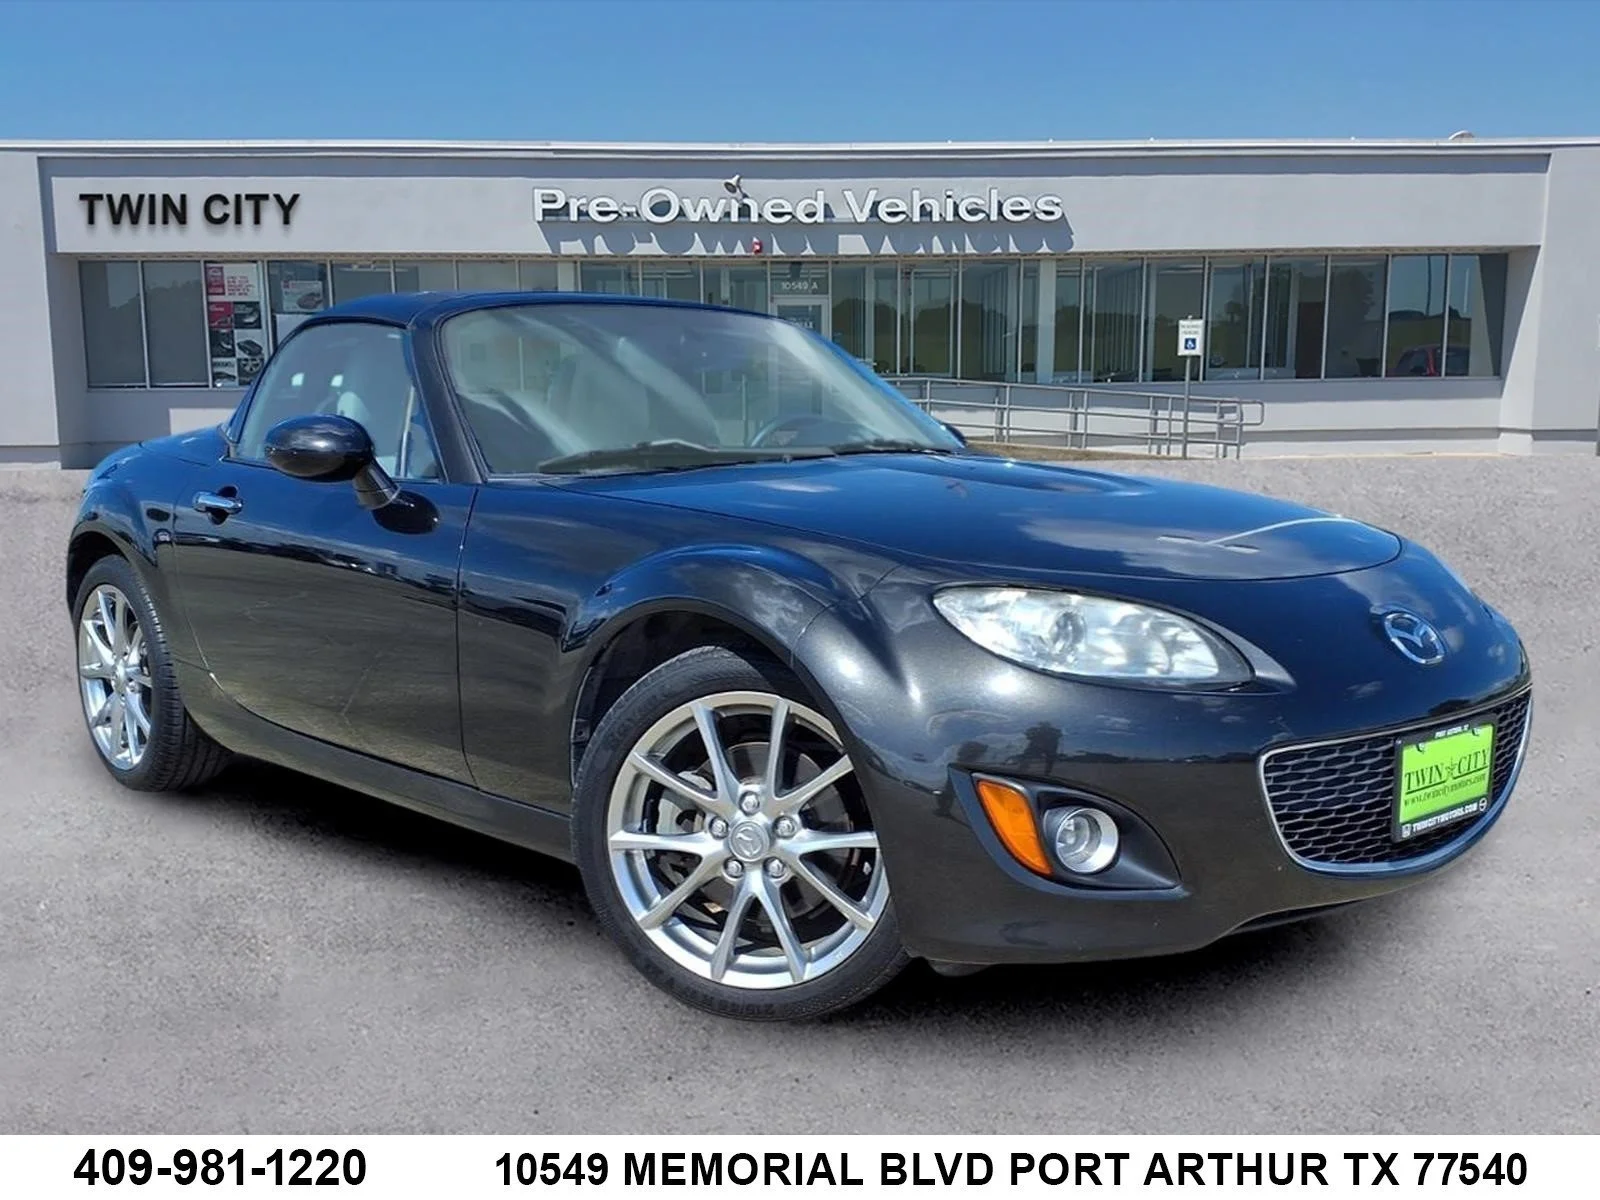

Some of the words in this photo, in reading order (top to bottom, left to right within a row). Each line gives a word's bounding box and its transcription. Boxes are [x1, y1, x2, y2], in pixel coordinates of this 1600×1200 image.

[79, 193, 188, 226] TWIN
[203, 193, 300, 226] CITY
[531, 187, 825, 225] Pre-Owned
[841, 186, 1064, 224] Vehicles
[1404, 763, 1445, 791] TWIN
[1457, 748, 1489, 775] CITY
